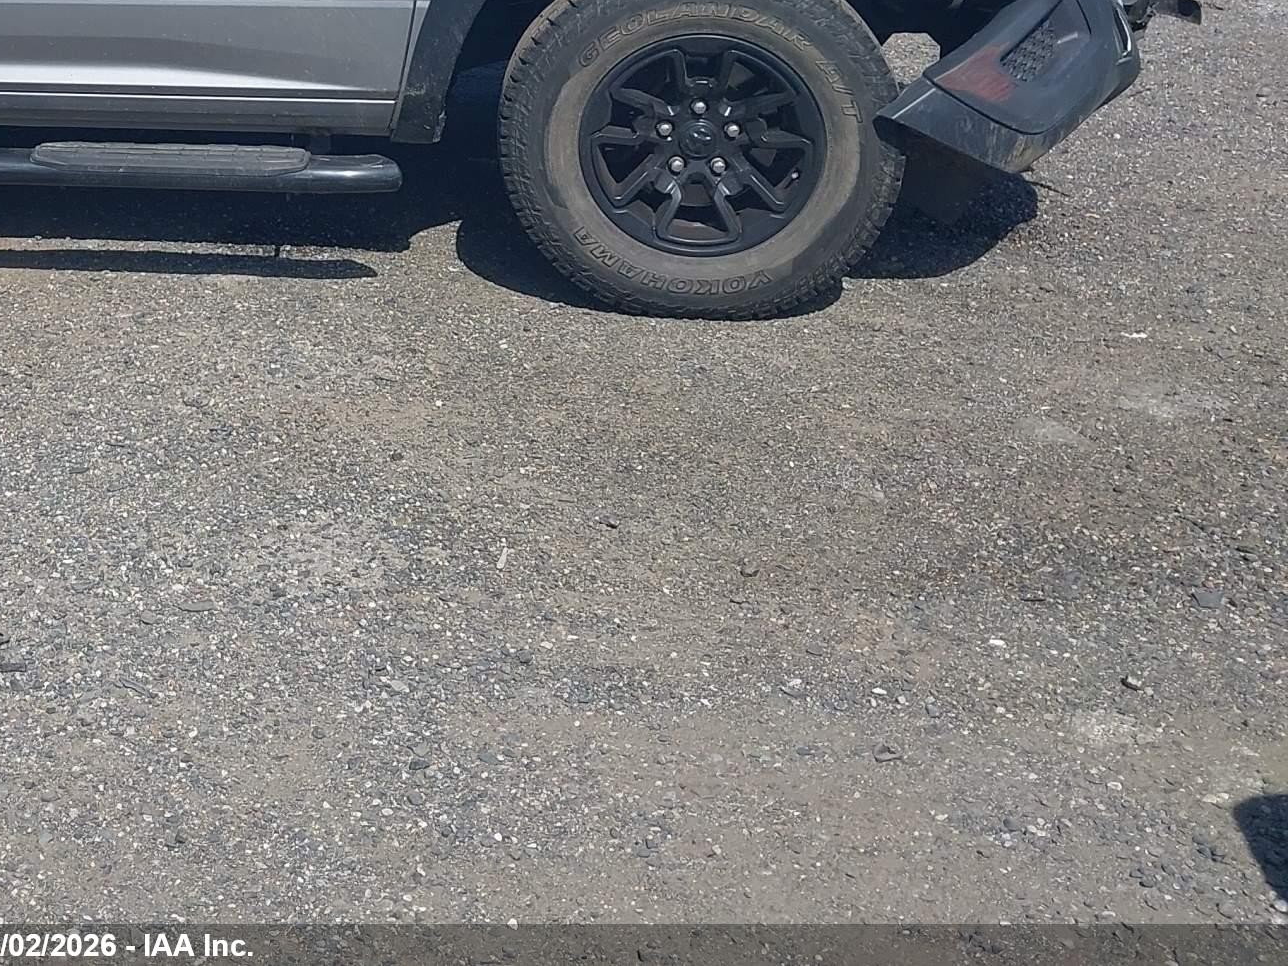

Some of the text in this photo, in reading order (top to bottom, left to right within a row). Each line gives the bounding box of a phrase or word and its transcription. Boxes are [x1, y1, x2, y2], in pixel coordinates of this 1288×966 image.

[578, 1, 863, 123] GEOLANDAR A/T
[574, 226, 772, 294] YOKOHAMA
